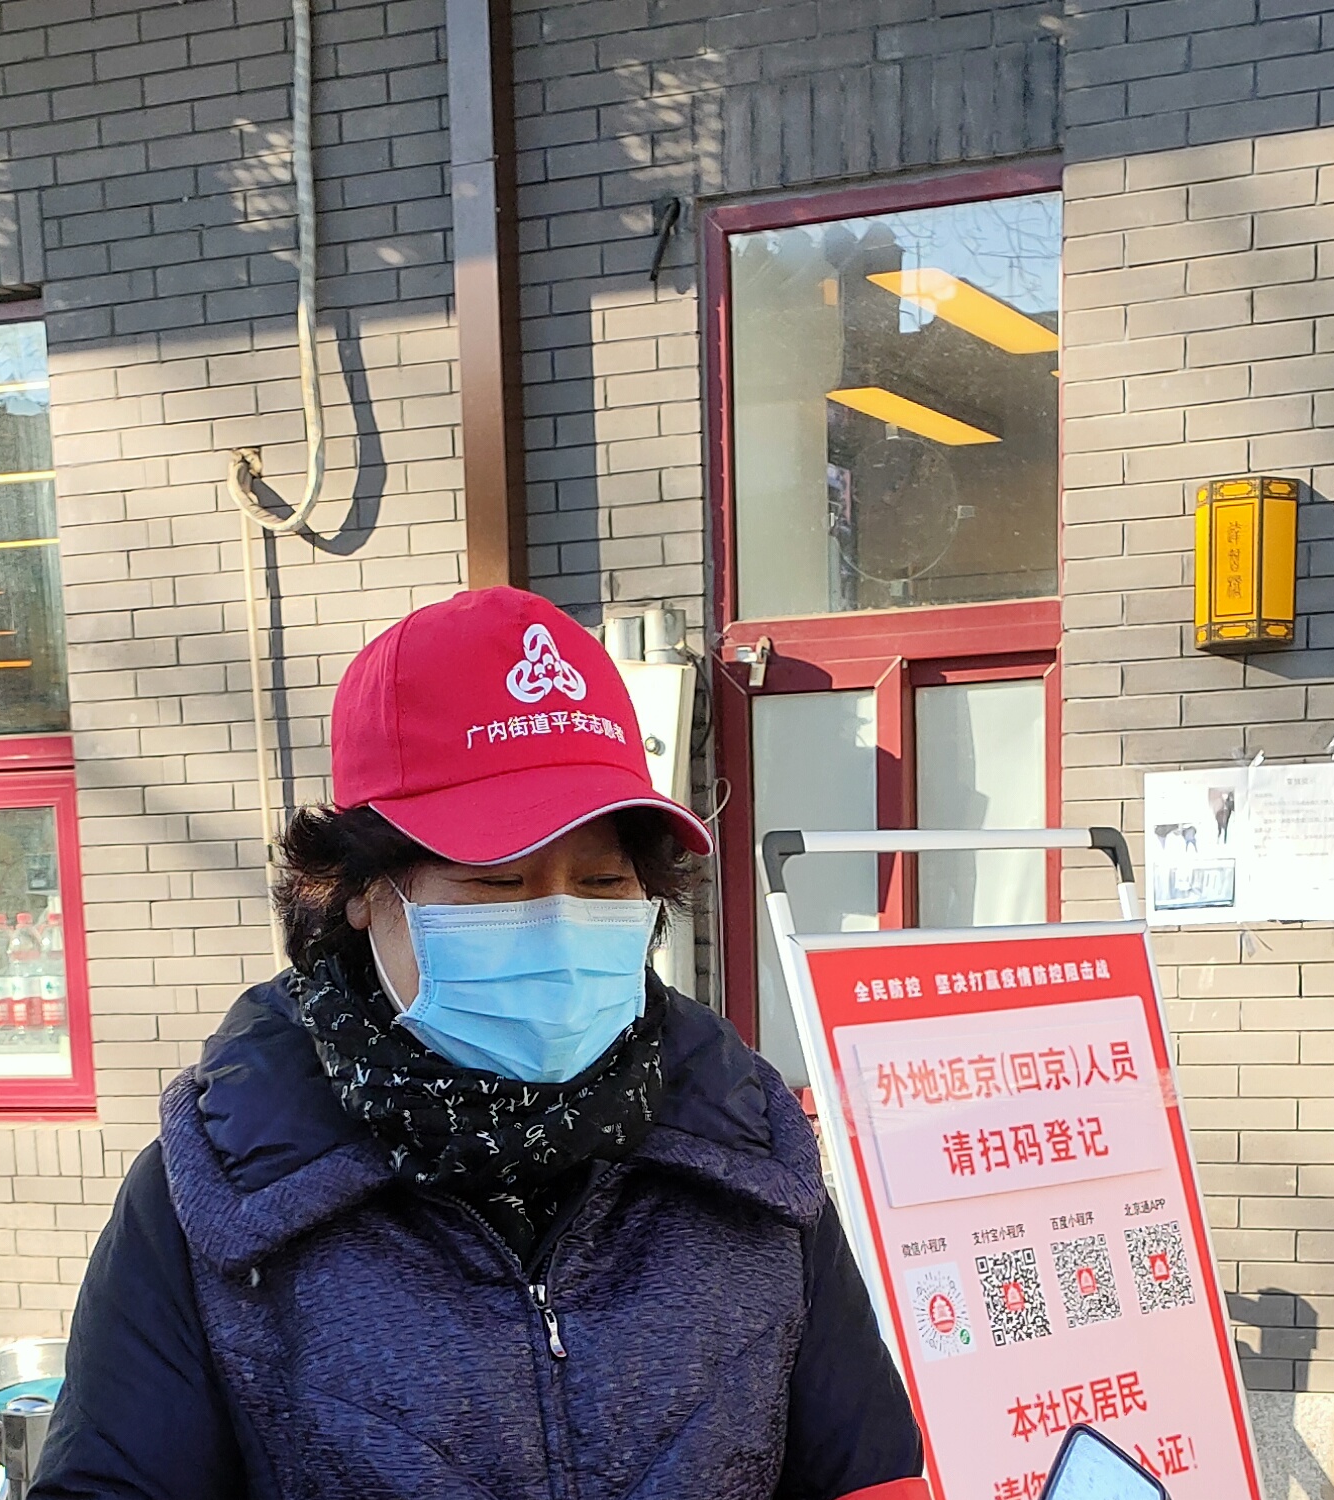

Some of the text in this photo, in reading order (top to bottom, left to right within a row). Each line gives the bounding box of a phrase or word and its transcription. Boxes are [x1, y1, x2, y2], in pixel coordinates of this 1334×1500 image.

[466, 710, 627, 750] 广内街道平安志愿者
[854, 959, 1111, 1003] 全民防控 坚决打赢疫情防控阻击战
[877, 1040, 1138, 1108] 外地返京(回京)人员
[942, 1116, 1109, 1176] 请扫码登记
[1050, 1211, 1094, 1231] 百度小程序
[1123, 1198, 1166, 1217] 北京通APP
[901, 1238, 948, 1258] 微信小程序
[971, 1223, 1025, 1246] 支付宝小程序
[1007, 1371, 1147, 1443] 本社区居民
